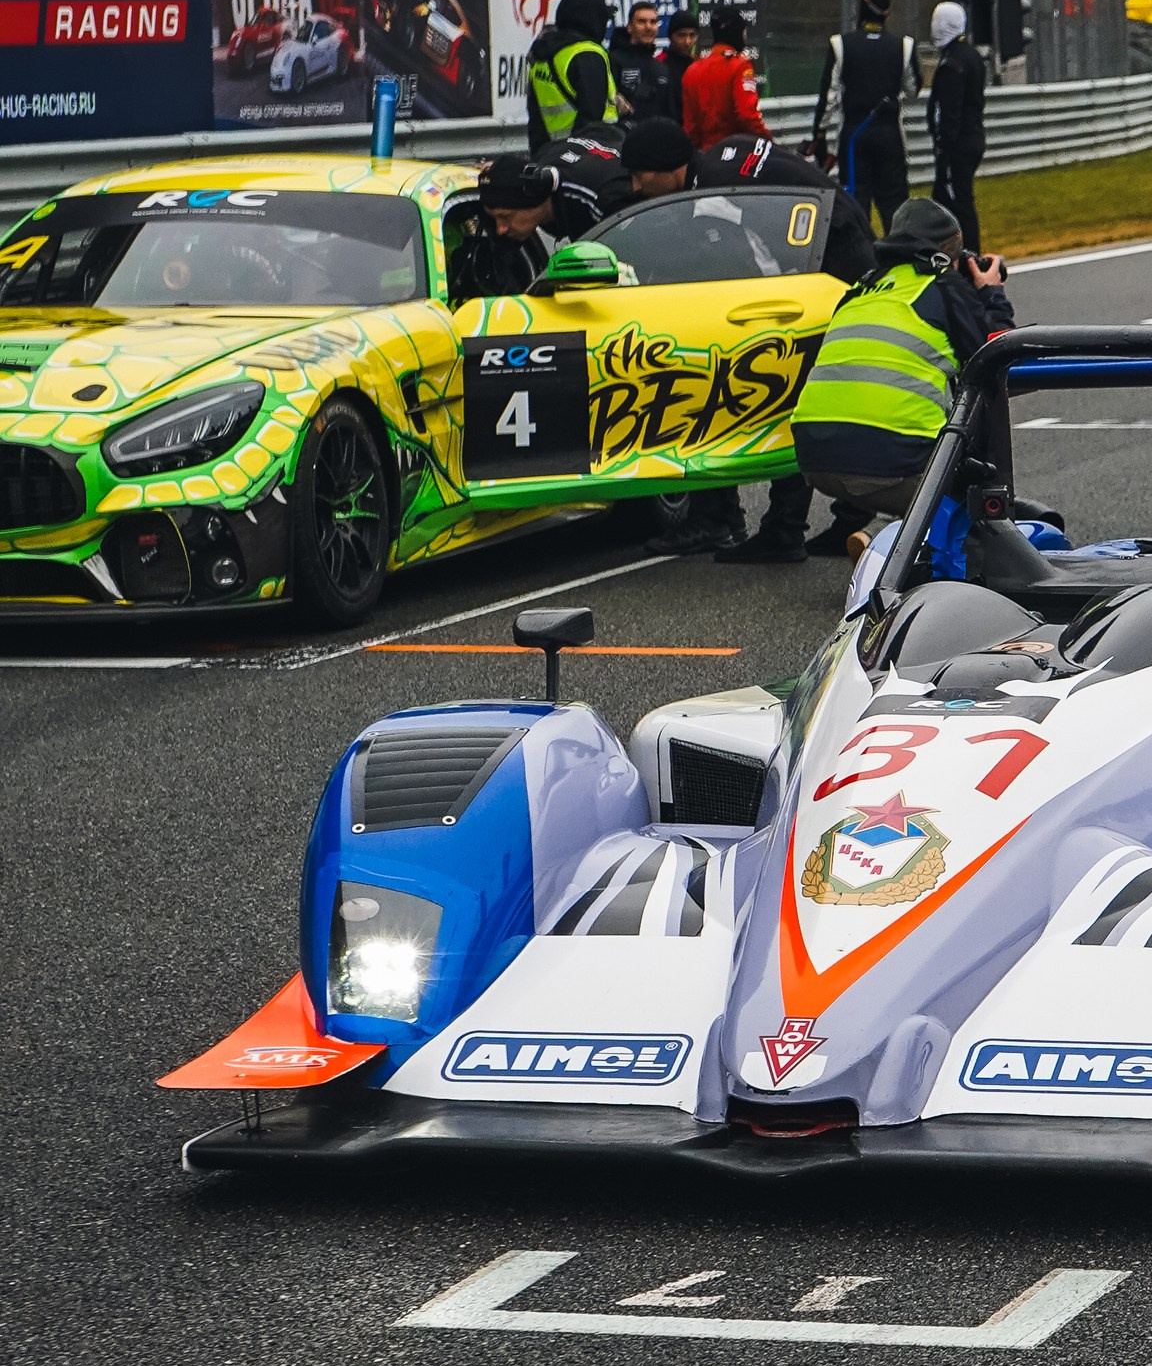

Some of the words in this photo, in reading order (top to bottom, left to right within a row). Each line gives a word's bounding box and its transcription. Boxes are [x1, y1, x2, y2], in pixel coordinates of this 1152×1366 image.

[55, 4, 180, 41] RACING
[602, 327, 674, 375] the
[589, 333, 826, 467] BEAST
[495, 390, 536, 448] 4
[813, 724, 1050, 802] 31
[838, 843, 884, 876] ЦСКА
[774, 1022, 807, 1056] TOW
[233, 1053, 338, 1065] AMK
[465, 1042, 672, 1074] AIMOL
